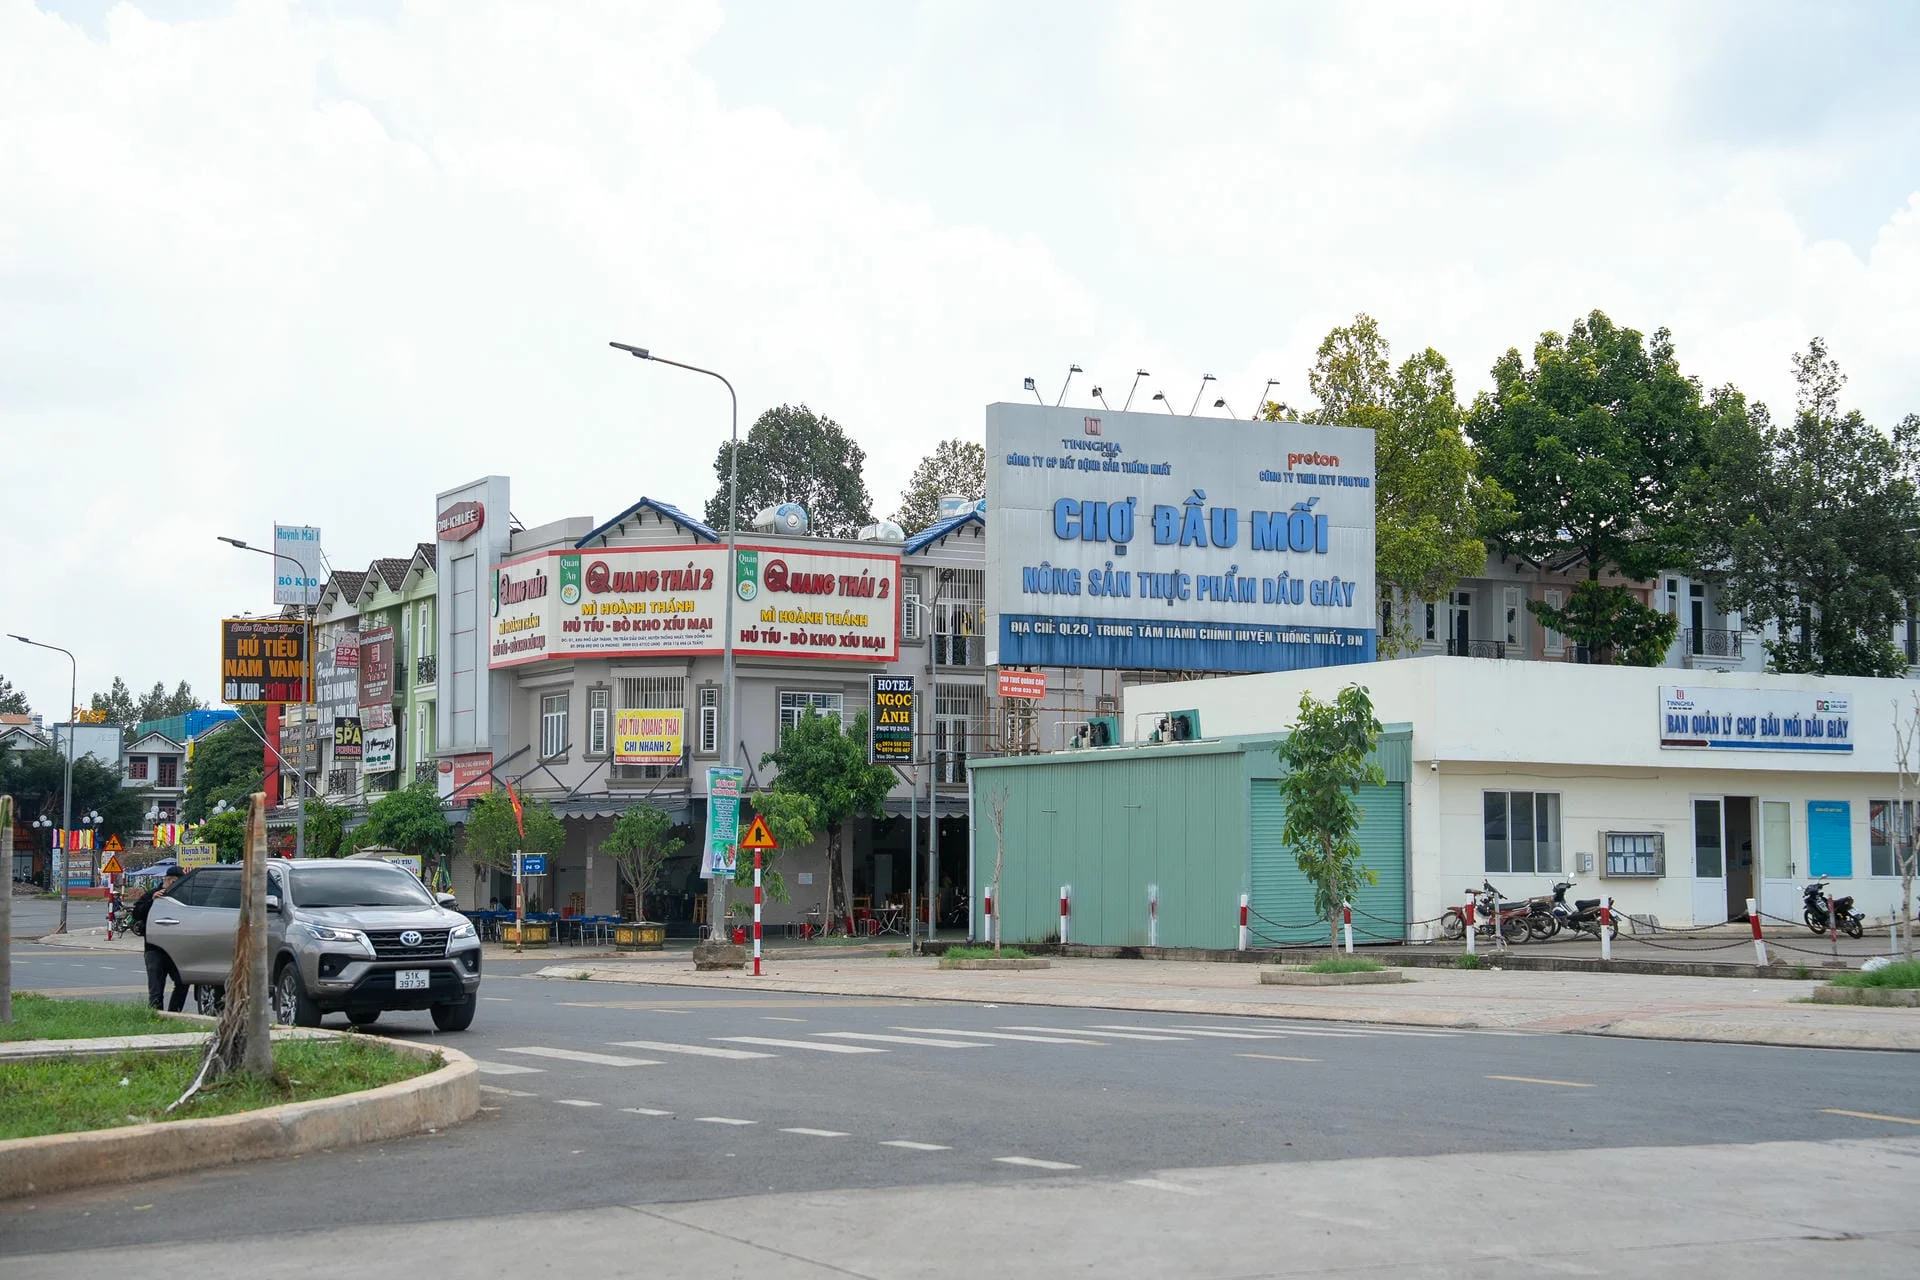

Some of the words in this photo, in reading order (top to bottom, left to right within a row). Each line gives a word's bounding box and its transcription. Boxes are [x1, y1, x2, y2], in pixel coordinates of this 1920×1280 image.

[1062, 439, 1122, 453] TINNGHIA
[1007, 452, 1031, 467] CÔNG
[1032, 456, 1043, 468] TY
[1046, 457, 1058, 468] CP
[1288, 451, 1340, 470] proton
[1259, 470, 1281, 483] CÔNG
[1283, 472, 1294, 483] TY
[1053, 496, 1137, 556] CHỢ
[1151, 488, 1238, 549] ĐẦU
[1251, 497, 1329, 554] MỐI
[301, 529, 314, 541] Mai
[278, 575, 292, 586] BÒ
[295, 577, 317, 587] KHO
[585, 560, 660, 594] QUANG
[660, 561, 700, 592] THÁI
[701, 568, 714, 590] 2
[764, 559, 836, 595] QUANG
[838, 568, 875, 598] THÁI
[877, 577, 890, 599] 2
[1022, 561, 1081, 596] NÔNG
[1088, 560, 1131, 598] SẢN
[1137, 567, 1191, 606] THỰC
[1197, 564, 1257, 603] PHẨM
[1263, 570, 1305, 605] DẦU
[1310, 575, 1356, 607] GIÂY
[581, 599, 597, 616] MÌ
[600, 598, 646, 615] HOÀNH
[650, 597, 695, 614] THÁNH
[563, 616, 581, 632] HỦ
[584, 616, 604, 632] TÍU
[612, 616, 631, 632] BÒ
[633, 619, 661, 631] KHO
[663, 615, 686, 631] XÍU
[687, 617, 713, 633] MẠI
[760, 605, 776, 622] MÌ
[779, 606, 824, 625] HOÀNH
[826, 609, 869, 627] THÁNH
[740, 625, 758, 643] HỦ
[761, 626, 782, 643] TÍU
[790, 628, 808, 645] BÒ
[809, 633, 837, 647] KHO
[839, 631, 860, 648] XÍU
[862, 635, 886, 652] MẠI
[1010, 621, 1030, 636] ĐỊA
[1034, 619, 1056, 634] CHỈ:
[1059, 623, 1092, 638] QL20,
[1096, 624, 1133, 637] TRUNG
[1138, 624, 1163, 638] TÂM
[1166, 624, 1196, 640] HÀNH
[1199, 626, 1232, 641] CHÍNH
[1235, 629, 1273, 645] HUYỆN
[1275, 629, 1311, 644] THỐNG
[1314, 629, 1345, 647] NHẤT,
[1347, 634, 1363, 647] ĐN
[237, 634, 259, 656] HỦ
[263, 633, 298, 657] TIẾU
[337, 647, 358, 657] SPA
[225, 659, 263, 677] NAM
[225, 679, 238, 700] BÒ
[240, 682, 260, 700] KHO
[877, 680, 912, 691] HOTEL
[876, 694, 912, 708] NGỌC
[880, 708, 910, 723] ÁNH
[1667, 714, 1688, 734] BAN
[1692, 709, 1719, 735] QUẢN
[1722, 712, 1733, 735] LÝ
[1737, 716, 1756, 739] CHỢ
[1761, 712, 1780, 736] ĐẦU
[1783, 712, 1802, 737] MỐI
[1805, 712, 1824, 738] DẦU
[335, 726, 362, 744] SPA
[642, 718, 662, 737] QUANG
[624, 741, 636, 752] CHI
[639, 739, 664, 752] NHÁNH
[666, 741, 672, 752] 2
